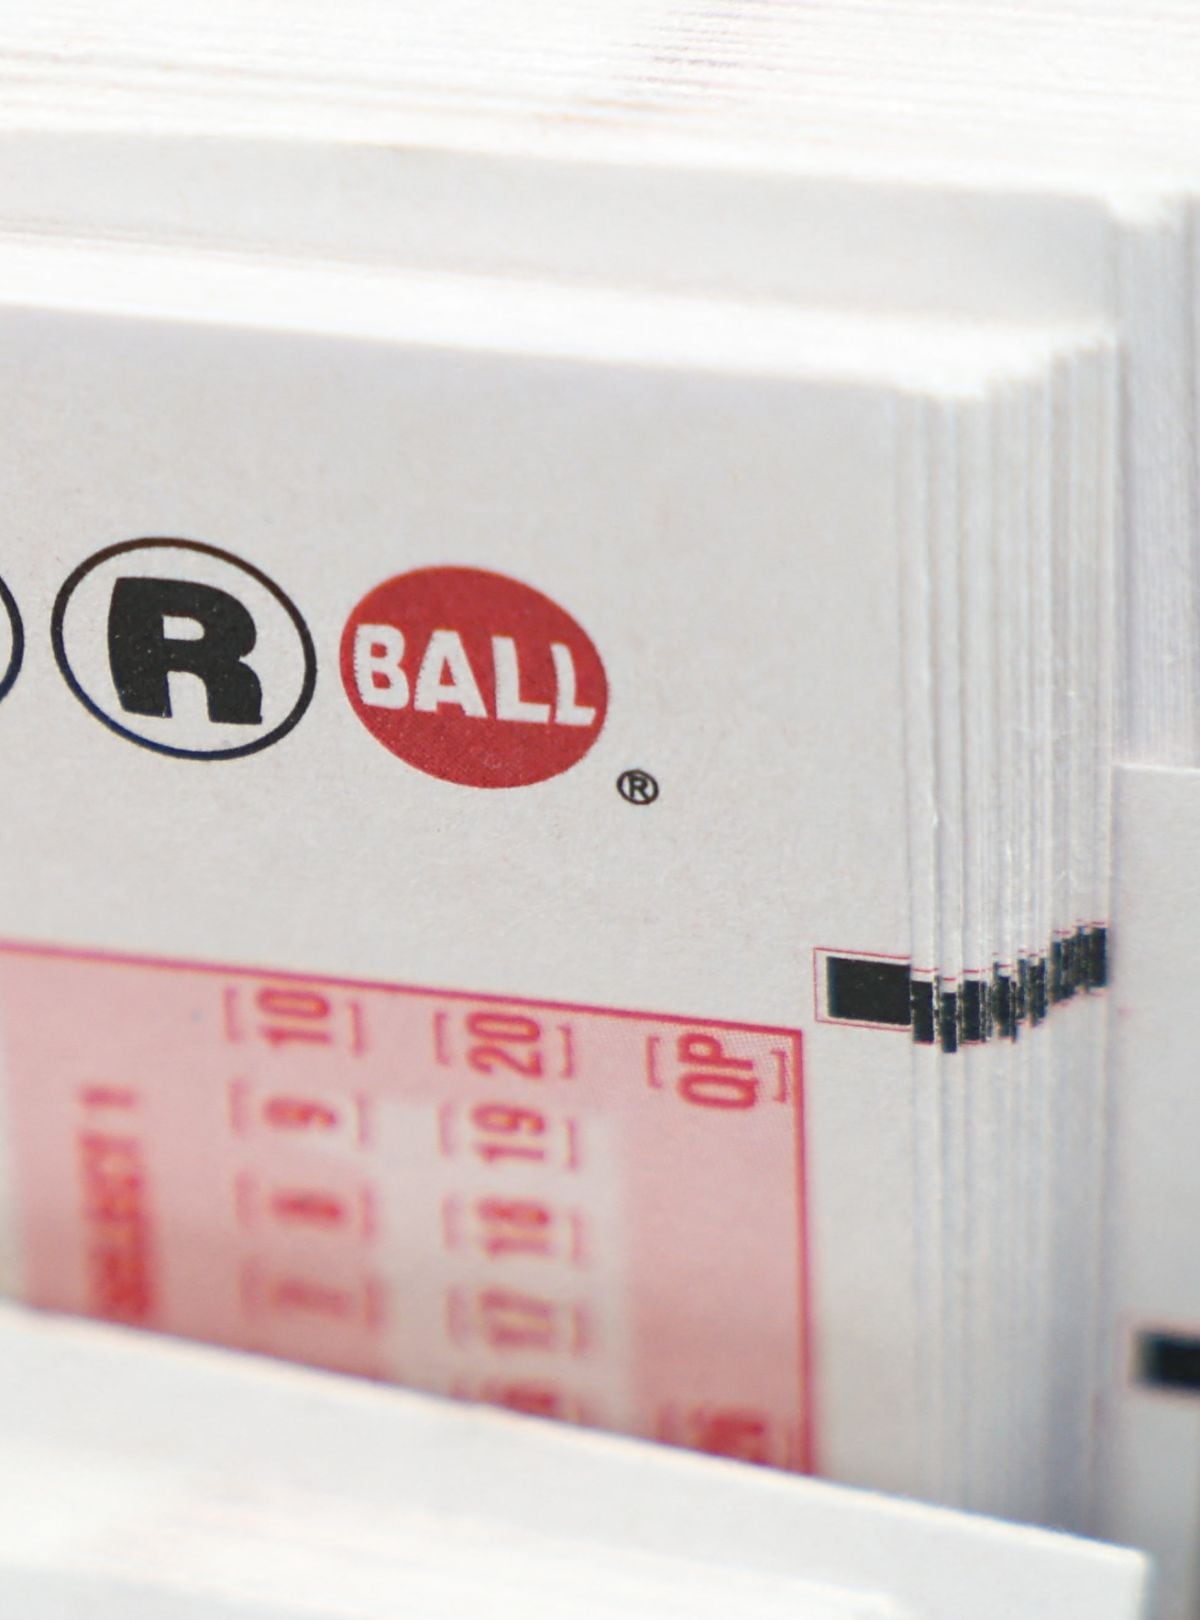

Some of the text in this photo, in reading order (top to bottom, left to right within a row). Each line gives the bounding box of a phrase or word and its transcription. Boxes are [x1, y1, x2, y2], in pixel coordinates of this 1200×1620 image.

[353, 622, 599, 727] BALL
[257, 986, 333, 1049] 10
[467, 1011, 545, 1079] 20
[676, 1032, 758, 1111] QP
[263, 1097, 338, 1131] 9
[472, 1102, 549, 1164] 19
[477, 1200, 553, 1258] 18
